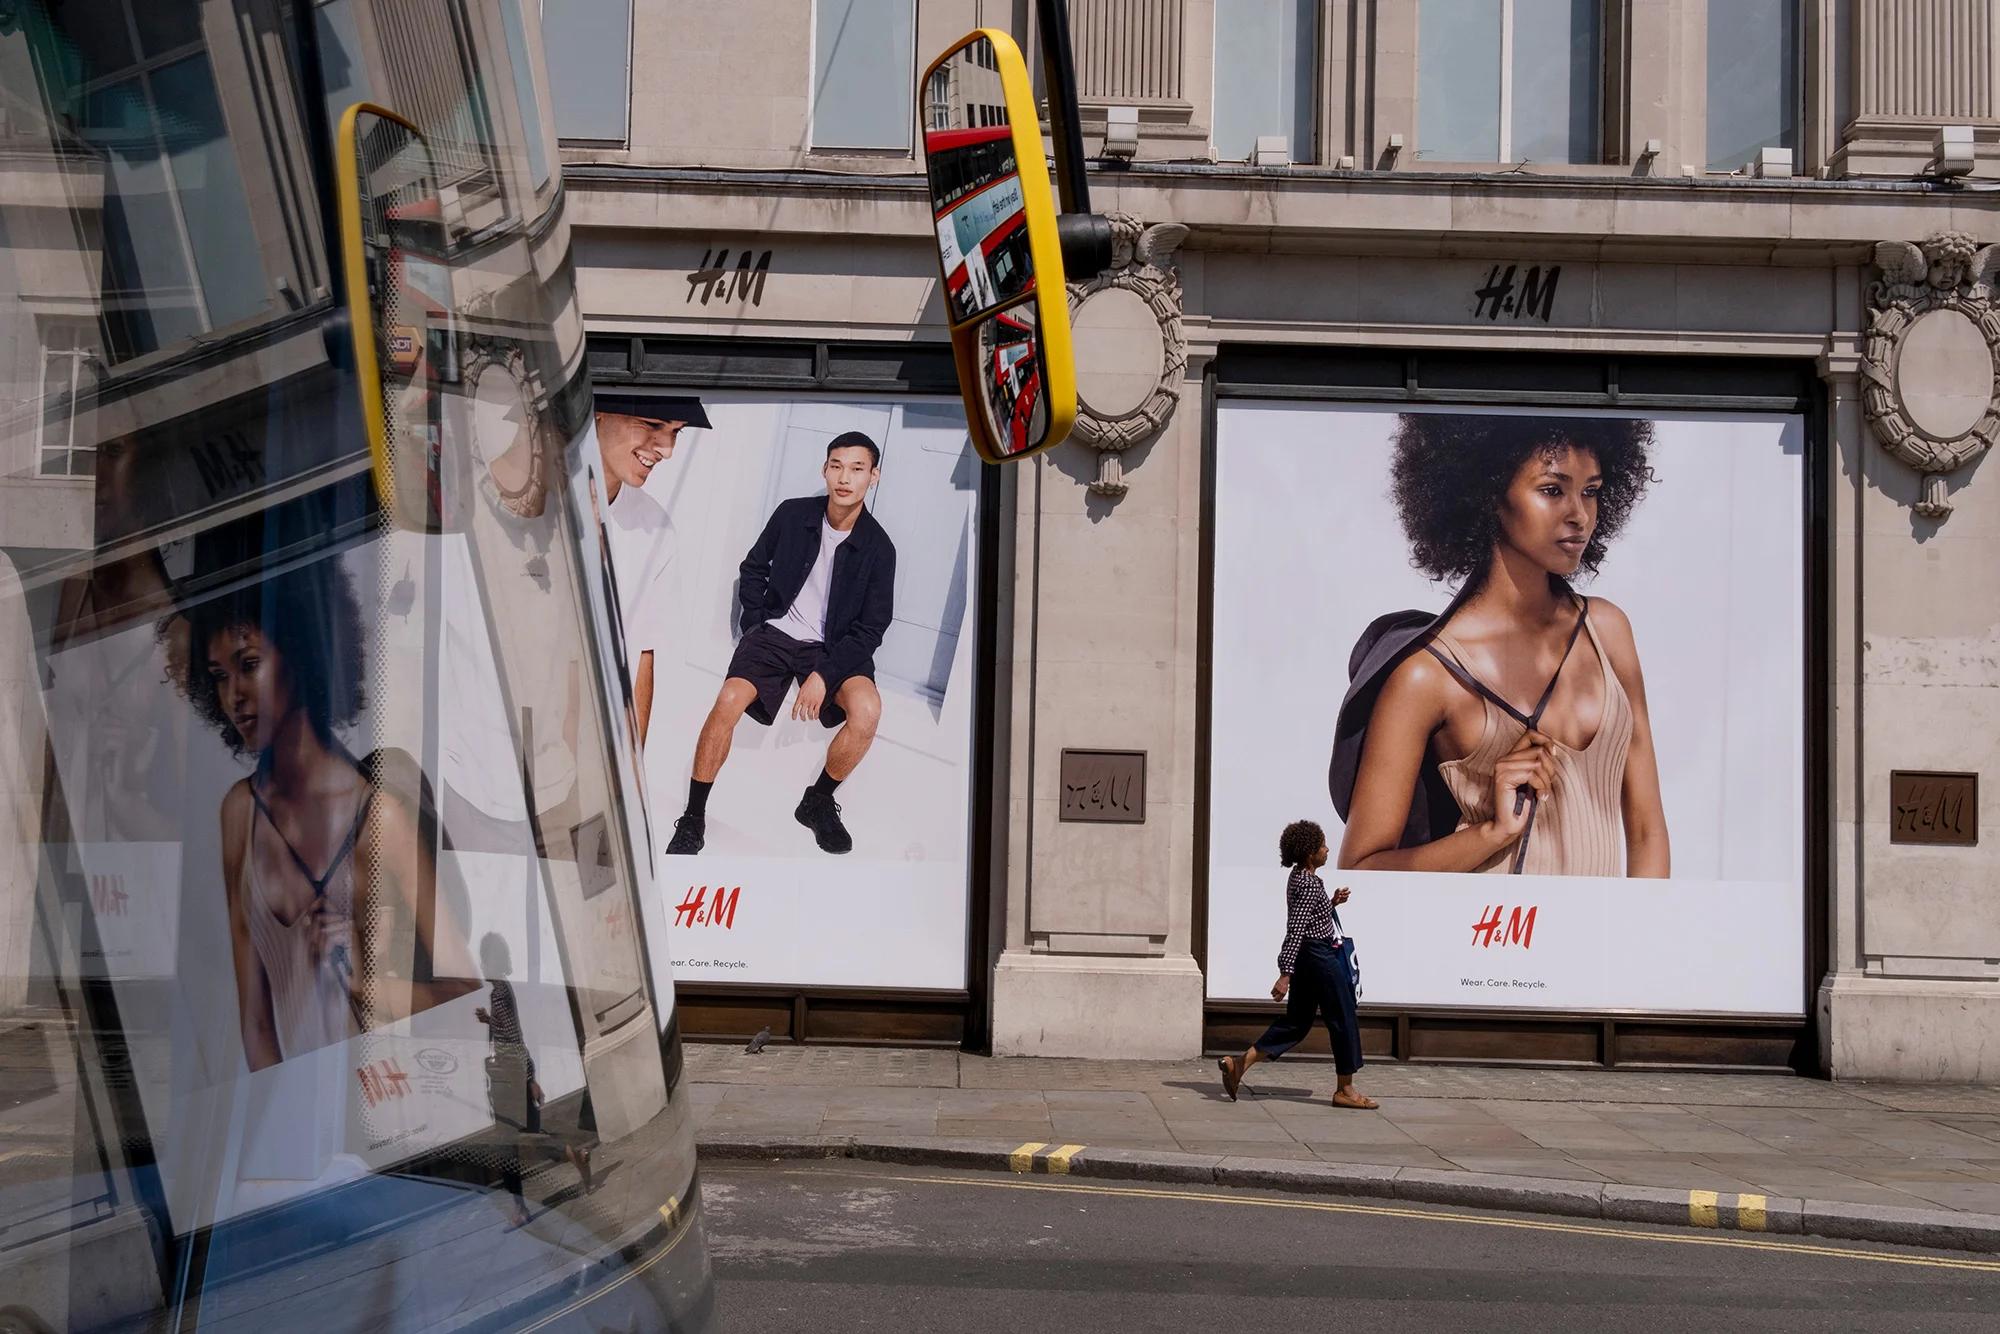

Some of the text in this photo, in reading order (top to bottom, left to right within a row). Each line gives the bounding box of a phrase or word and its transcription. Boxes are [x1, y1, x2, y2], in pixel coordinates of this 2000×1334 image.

[686, 249, 773, 308] H&M
[1474, 264, 1562, 323] H&M
[1897, 784, 1968, 834] H&M
[673, 885, 742, 931] H&M
[1471, 904, 1538, 950] H&M
[670, 958, 749, 970] ear. Care. Recycle.
[1460, 978, 1548, 990] Wear. Care. Recycle.
